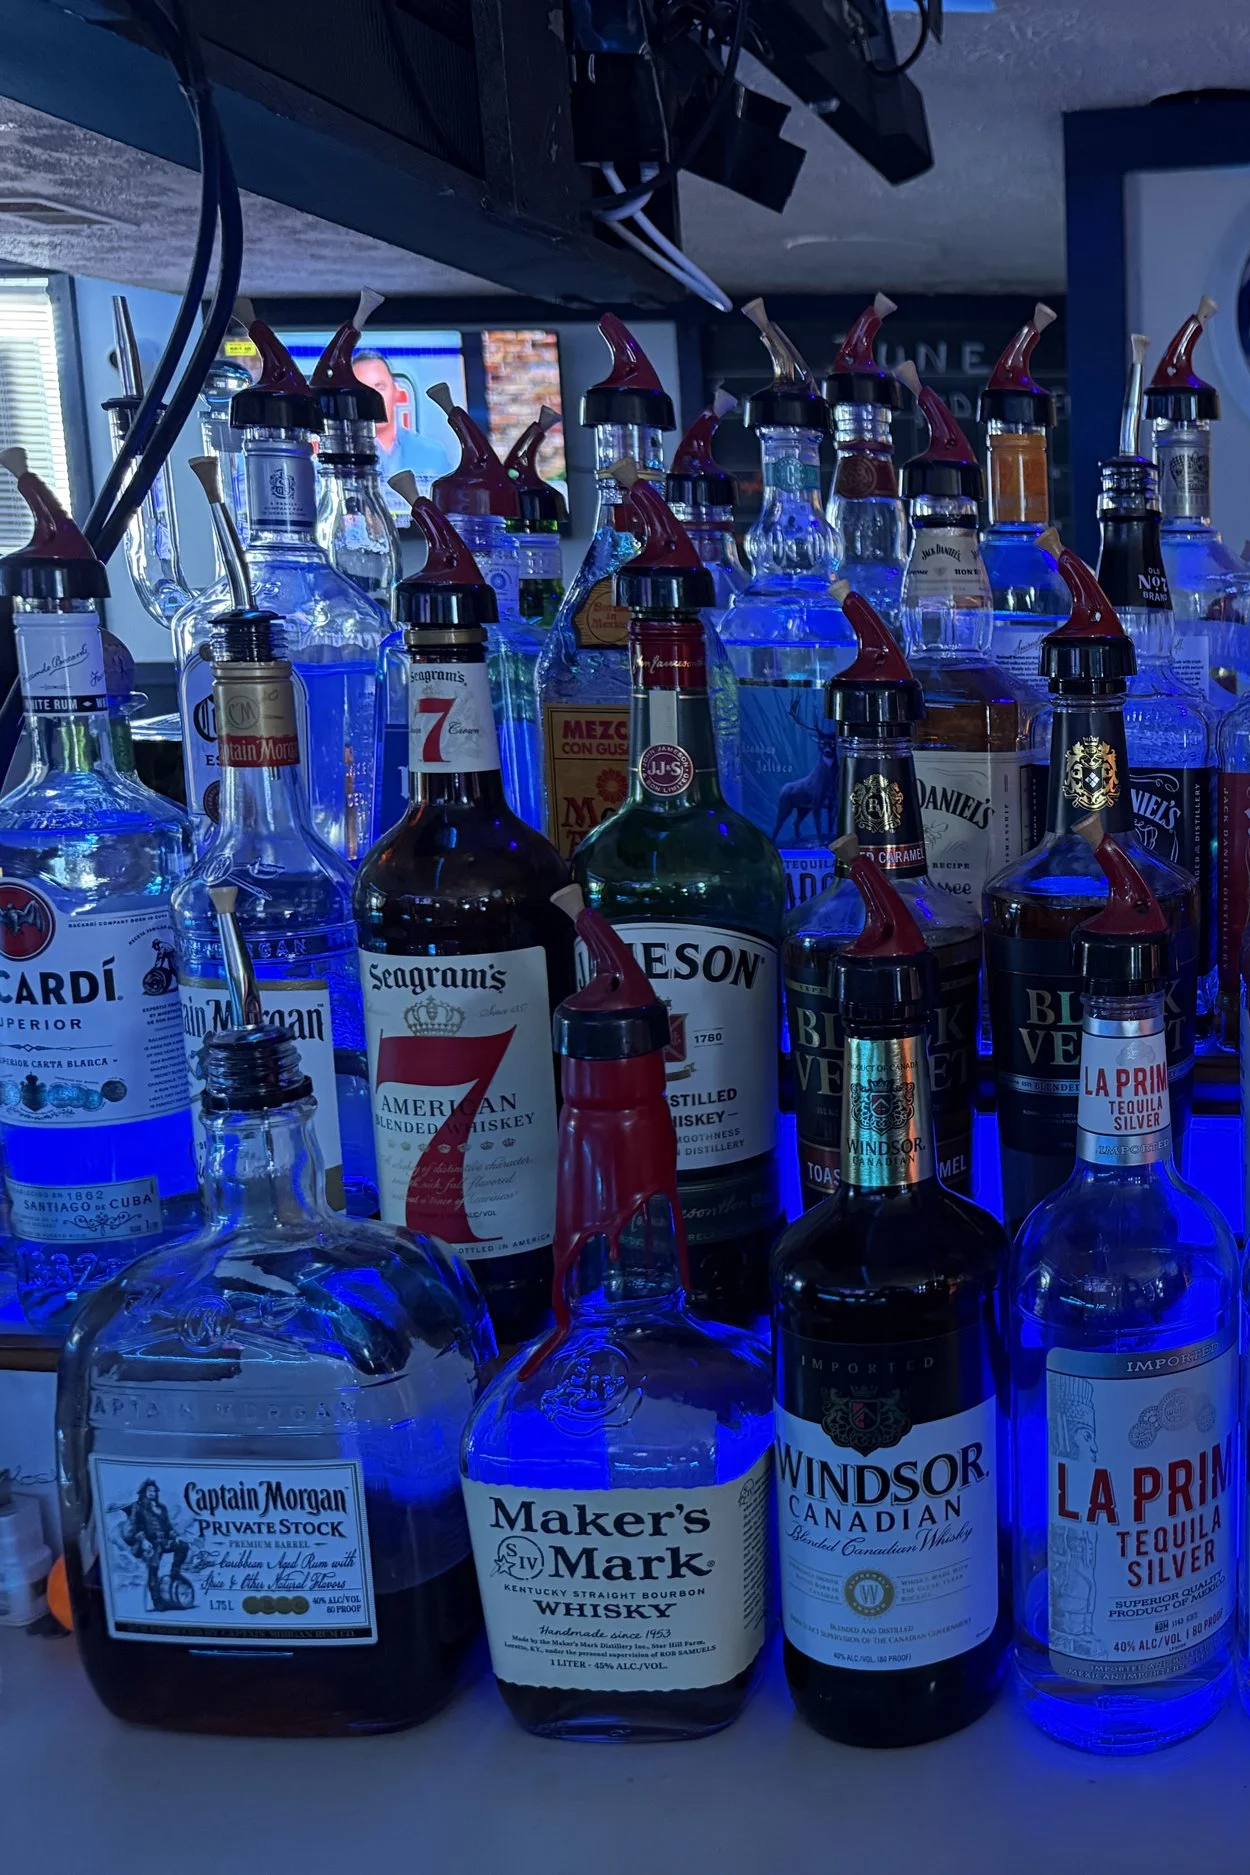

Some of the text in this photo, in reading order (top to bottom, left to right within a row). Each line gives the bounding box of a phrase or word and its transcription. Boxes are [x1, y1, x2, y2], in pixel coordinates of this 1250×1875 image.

[1148, 567, 1161, 576] OLD
[1142, 591, 1168, 602] BRAND
[54, 699, 78, 710] RUM
[448, 721, 480, 735] Crown
[562, 742, 591, 755] CON
[879, 849, 925, 865] CARAMEL
[98, 919, 129, 927] COMPANY
[369, 962, 508, 996] Seagram's
[693, 1031, 723, 1044] 1780
[31, 1057, 109, 1069] CARTA BLANCA
[889, 1060, 919, 1072] CANADA
[1084, 1066, 1109, 1097] LA
[380, 1092, 518, 1120] AMERICAN
[1108, 1095, 1163, 1115] TEQUILA
[376, 1112, 536, 1136] BLENDED WHISKEY
[1113, 1112, 1160, 1131] SILVER
[374, 1024, 519, 1245] 7
[685, 1139, 746, 1156] DISTILLERY
[1097, 1139, 1169, 1155] IMPORTED
[852, 1153, 916, 1167] CANADIAN
[24, 1194, 153, 1212] SANTIAGO CUBA
[66, 1190, 104, 1200] 1862
[498, 1233, 551, 1250] IN AMERICA
[801, 1355, 935, 1376] IMPORTED
[1127, 1341, 1220, 1373] IMPORTED
[184, 1480, 349, 1518] Captain Morgan
[1057, 1462, 1119, 1526] LA
[488, 1496, 711, 1538] Maker's
[788, 1494, 961, 1533] CANADIAN
[195, 1518, 349, 1539] PRIVATE STOCK
[1117, 1504, 1222, 1559] TEQUILA
[229, 1540, 311, 1549] PREMIUM BARREL
[786, 1520, 974, 1557] Blended Canadian Whisky
[301, 1549, 358, 1570] Rum with
[547, 1544, 716, 1581] Mark
[1127, 1539, 1216, 1589] SILVER
[240, 1571, 347, 1592] Other Natural Flavors
[1115, 1568, 1224, 1610] SUPERIOR QUALITY
[503, 1582, 706, 1600] KENTUCKY STRAIGHT BOURBON
[1108, 1575, 1226, 1618] PRODUCT MEXICO
[336, 1605, 362, 1614] PROOF
[532, 1599, 679, 1620] WHISKY
[538, 1624, 673, 1640] Handmade since 1953
[1138, 1632, 1182, 1650] ALC/VOL
[678, 1644, 718, 1656] SAMUELS
[557, 1658, 615, 1670] LITER 45%
